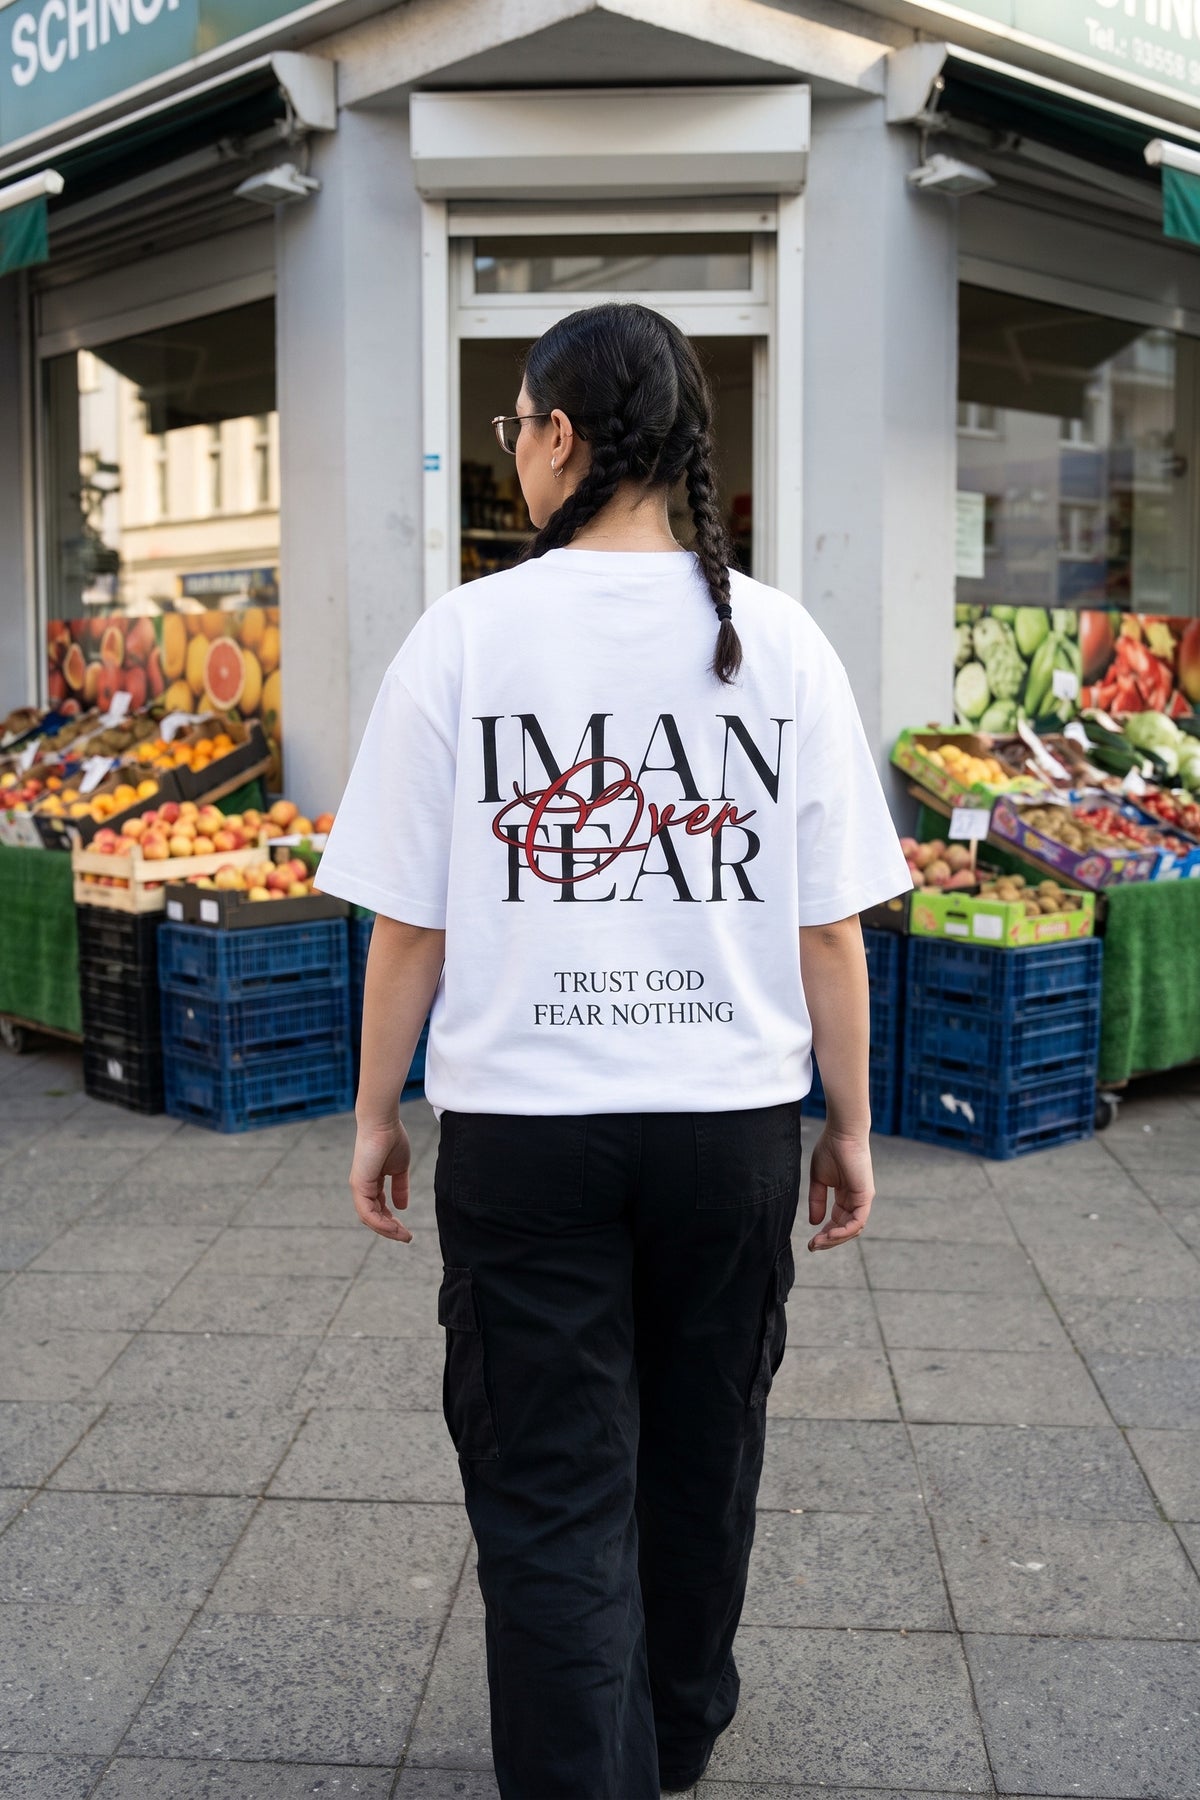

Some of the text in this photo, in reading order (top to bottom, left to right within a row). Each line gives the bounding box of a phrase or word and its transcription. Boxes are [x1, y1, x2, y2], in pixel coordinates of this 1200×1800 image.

[472, 713, 794, 804] IMAN
[492, 756, 757, 884] Over
[501, 822, 765, 903] FEAR
[533, 1001, 734, 1026] FEAR NOTHING
[553, 969, 705, 993] TRUST GOD
